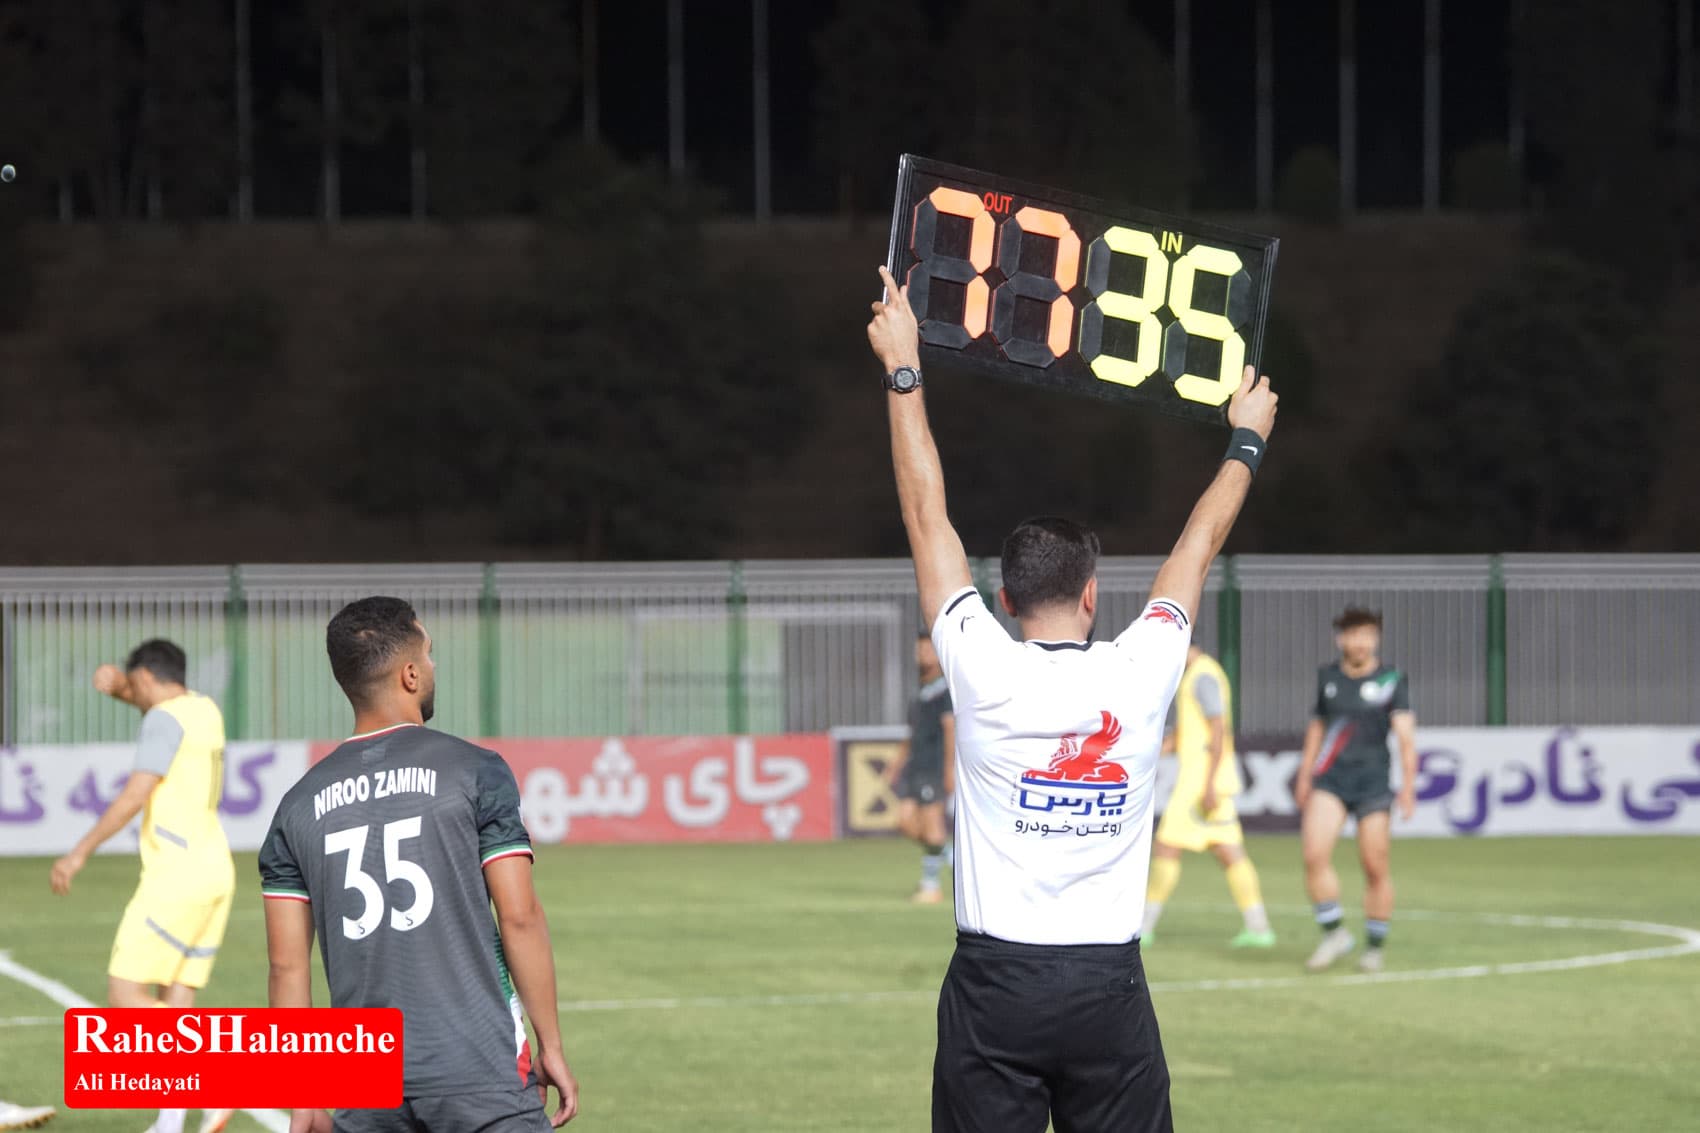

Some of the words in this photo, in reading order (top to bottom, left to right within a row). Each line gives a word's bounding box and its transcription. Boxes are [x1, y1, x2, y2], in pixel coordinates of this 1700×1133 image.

[983, 192, 1013, 214] OUT
[1160, 231, 1184, 254] IN
[928, 186, 1082, 359] 77
[1087, 225, 1246, 407] 35
[313, 774, 370, 821] NIROO
[374, 767, 437, 798] ZAMINI
[664, 738, 810, 840] چای
[1019, 789, 1127, 817] پارس
[1014, 819, 1073, 837] خودرو
[1075, 820, 1122, 837] روغن
[324, 815, 434, 940] 35
